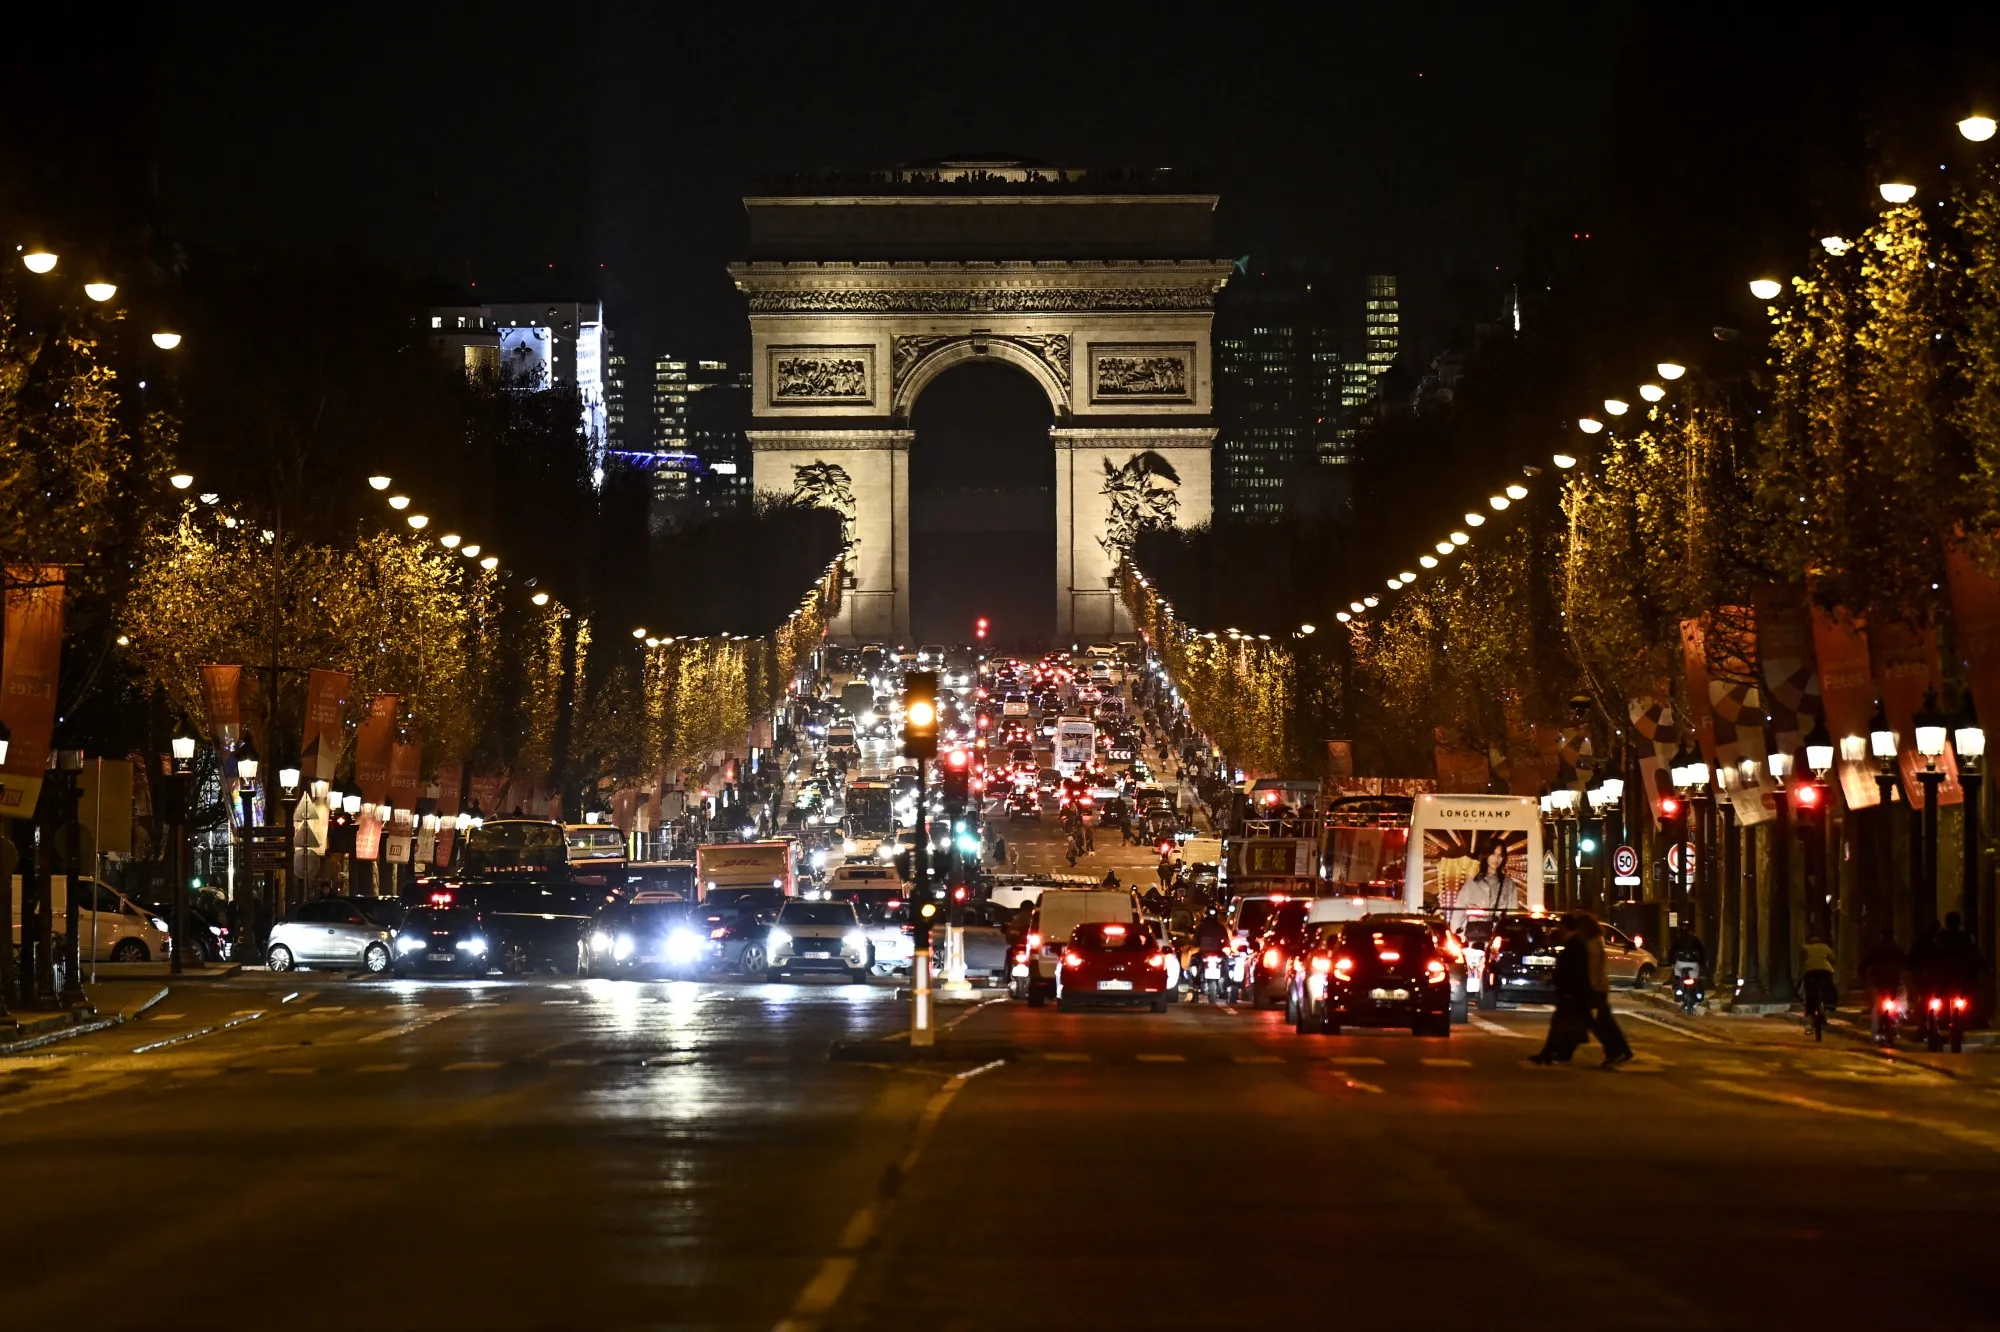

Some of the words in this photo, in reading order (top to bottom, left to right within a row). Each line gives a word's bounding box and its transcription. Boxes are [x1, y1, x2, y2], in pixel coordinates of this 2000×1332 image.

[1439, 809, 1511, 818] LONGCHAMP
[723, 858, 761, 867] DHL
[1619, 855, 1632, 868] 50
